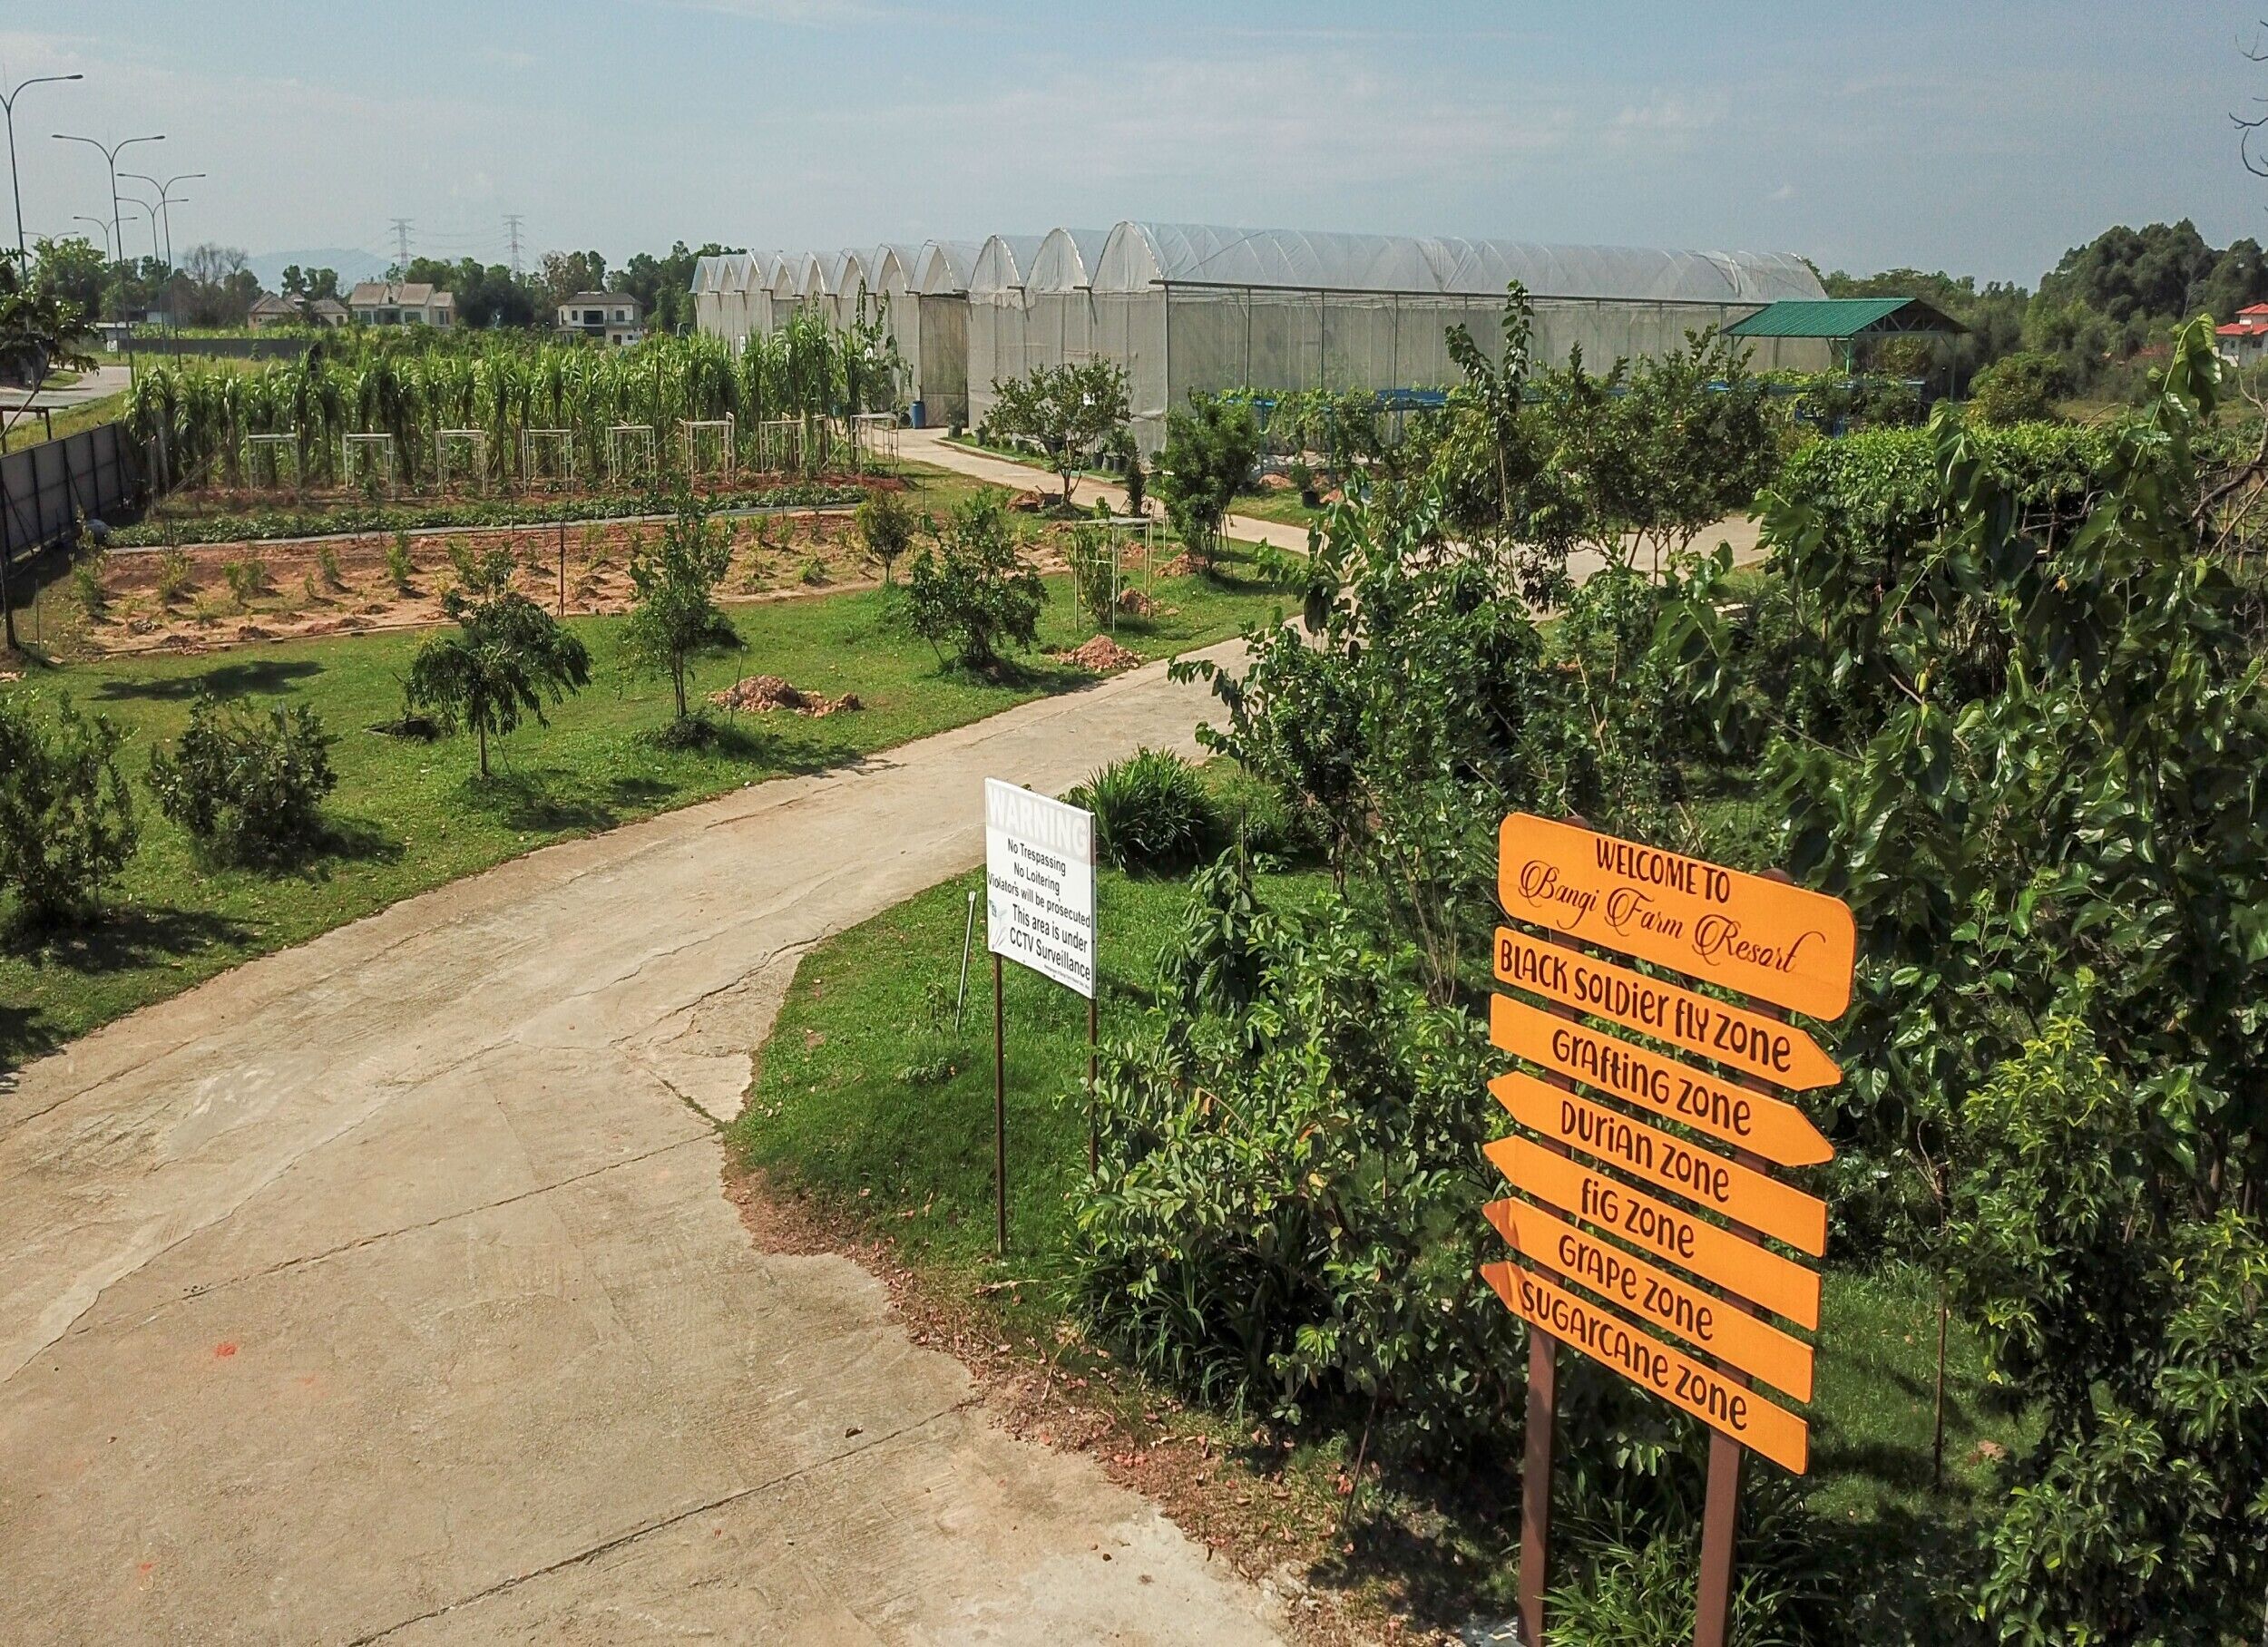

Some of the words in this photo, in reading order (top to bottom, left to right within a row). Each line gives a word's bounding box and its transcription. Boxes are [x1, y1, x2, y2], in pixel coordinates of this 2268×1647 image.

[987, 783, 1089, 855] WARNING
[1008, 838, 1018, 854] No
[1020, 843, 1066, 877] Trespassing
[1014, 862, 1024, 878] No
[1026, 867, 1060, 896] Loitering
[1597, 838, 1697, 895] WELCOME
[1704, 867, 1731, 903] TO
[988, 872, 1019, 897] Violators
[1021, 889, 1033, 903] will
[1035, 892, 1045, 908] be
[1046, 900, 1090, 928] prosecuted
[1518, 860, 1600, 931] Bangi
[1604, 887, 1685, 937] Farm
[1692, 914, 1826, 974] Resort
[1010, 927, 1034, 952] CCTV
[1036, 939, 1090, 981] Surveillance
[1012, 903, 1030, 927] This
[1032, 917, 1050, 936] area
[1052, 921, 1060, 940] is
[1061, 930, 1088, 953] under
[1501, 939, 1569, 994] BLACK
